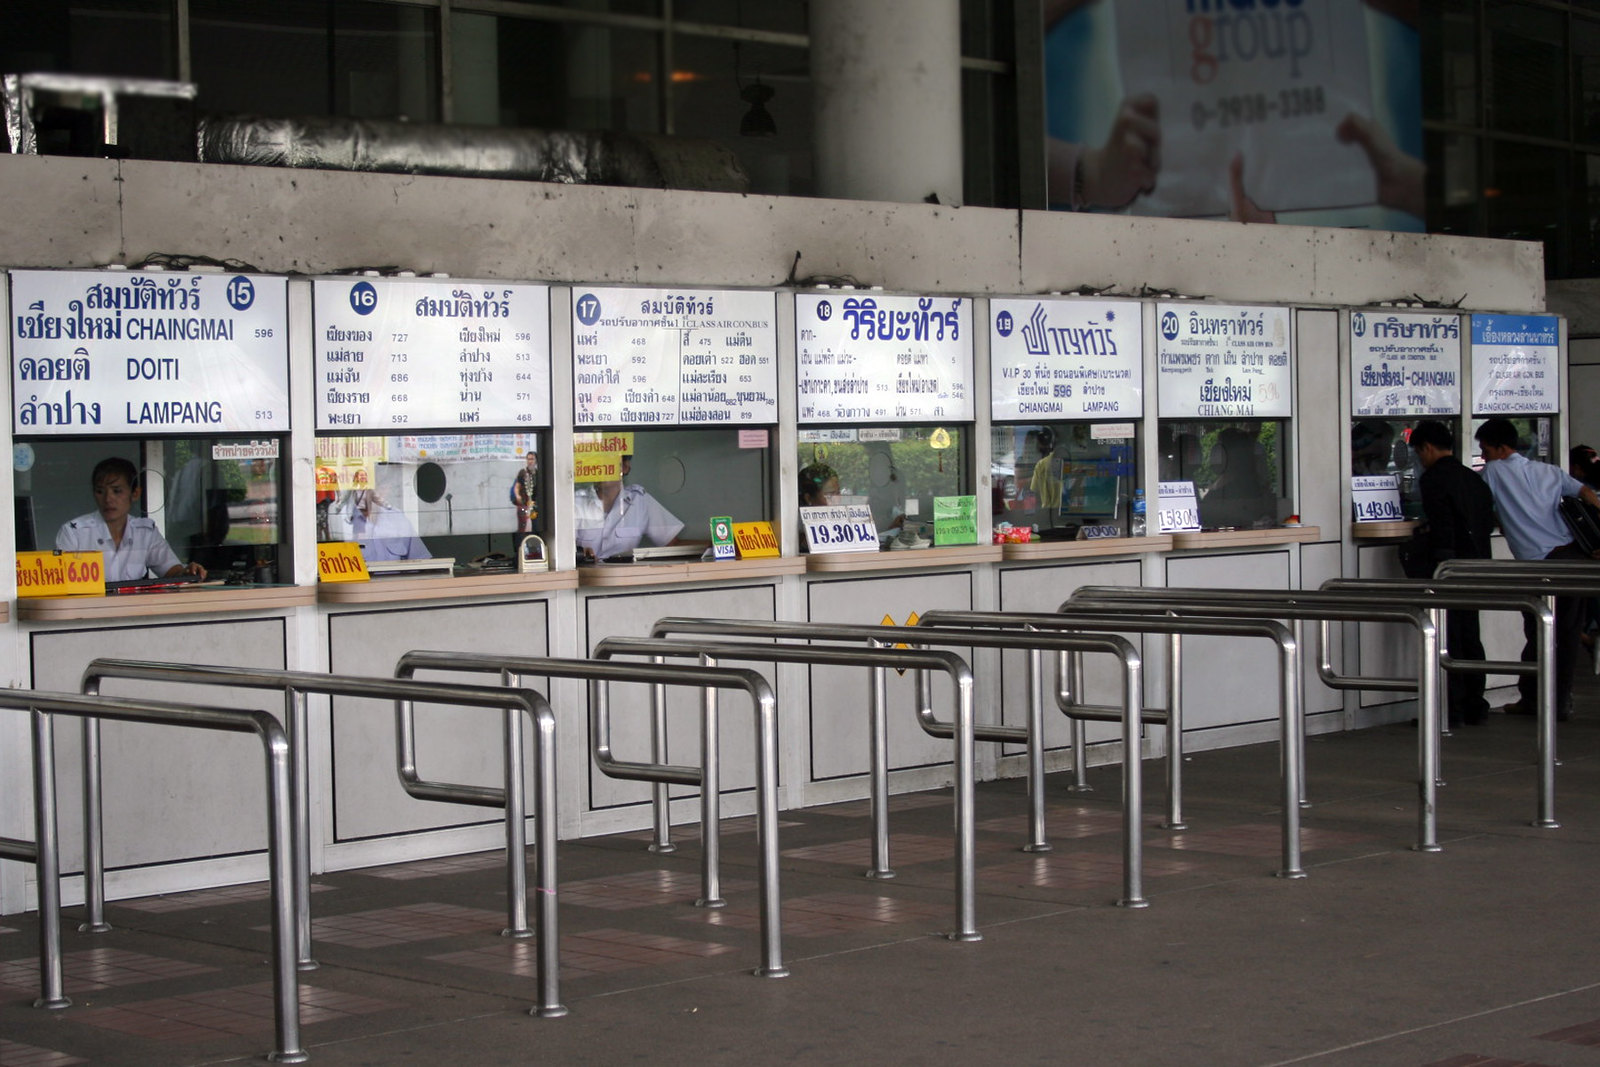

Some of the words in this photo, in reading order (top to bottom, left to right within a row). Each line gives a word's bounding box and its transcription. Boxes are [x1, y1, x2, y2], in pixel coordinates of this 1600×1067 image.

[1188, 10, 1314, 84] group
[86, 276, 202, 310] สมบัติทัวร์
[229, 281, 253, 305] 15
[353, 291, 374, 306] 16
[416, 290, 513, 318] สมบัติทัวร์
[580, 301, 597, 318] 17
[641, 295, 713, 315] สมบัติทัวร์
[18, 300, 122, 340] เชียงใหม่
[127, 318, 233, 341] CHAINGMAI
[255, 329, 273, 338] 596
[819, 304, 830, 317] 18
[843, 298, 962, 341] วิริยะทัวร์
[1163, 317, 1178, 334] 20
[1190, 311, 1264, 336] อินทราทัวร์
[327, 325, 372, 342] เชียงของ
[392, 334, 408, 342] 727
[460, 326, 500, 343] เชียงใหม่
[515, 333, 530, 341] 596
[1374, 317, 1458, 339] กริษาทัวร์
[577, 331, 597, 346] แพร่
[631, 338, 646, 346] 468
[699, 338, 711, 346] 475
[327, 347, 364, 363] แม่สาย
[391, 354, 407, 362] 713
[460, 349, 491, 363] ลำปาง
[577, 353, 607, 365] พะเยา
[632, 356, 646, 364] 592
[1205, 353, 1220, 365] ตาก
[1241, 350, 1264, 365] ลำปาง
[19, 347, 90, 380] ดอยติ
[127, 358, 179, 380] DOITI
[327, 367, 360, 383] แม่จัน
[391, 374, 408, 382] 686
[460, 368, 492, 387] ทุ่งช้าง
[516, 373, 531, 381] 644
[739, 375, 752, 383] 653
[1023, 370, 1032, 379] 30
[327, 388, 369, 404] เชียงราย
[391, 394, 408, 402] 668
[460, 390, 481, 402] น่าน
[516, 393, 530, 401] 571
[1017, 382, 1050, 396] เชียงใหม่
[1053, 384, 1072, 398] 596
[1083, 382, 1105, 395] ลำปาง
[1200, 377, 1252, 403] เชียงใหม่
[20, 389, 101, 425] ลำปาง
[127, 401, 221, 424] LAMPANG
[256, 410, 273, 420] 513
[597, 396, 612, 404] 623
[662, 395, 675, 403] 648
[1019, 402, 1063, 414] CHIANGMAI
[1083, 401, 1119, 413] LAMPANG
[460, 408, 480, 423] แพร่
[516, 413, 532, 422] 468
[662, 413, 674, 421] 727
[1198, 405, 1234, 416] CHIANG
[1236, 405, 1255, 416] MAI
[328, 413, 361, 425] พะเยา
[392, 415, 408, 423] 592
[574, 460, 615, 477] ชียงราย
[737, 526, 777, 551] เชียงใหม่
[810, 523, 854, 545] 19.30
[717, 545, 735, 555] VISA
[319, 552, 361, 576] ลำปาง
[16, 558, 65, 587] ชียงใหม่
[68, 562, 99, 583] 6.00
